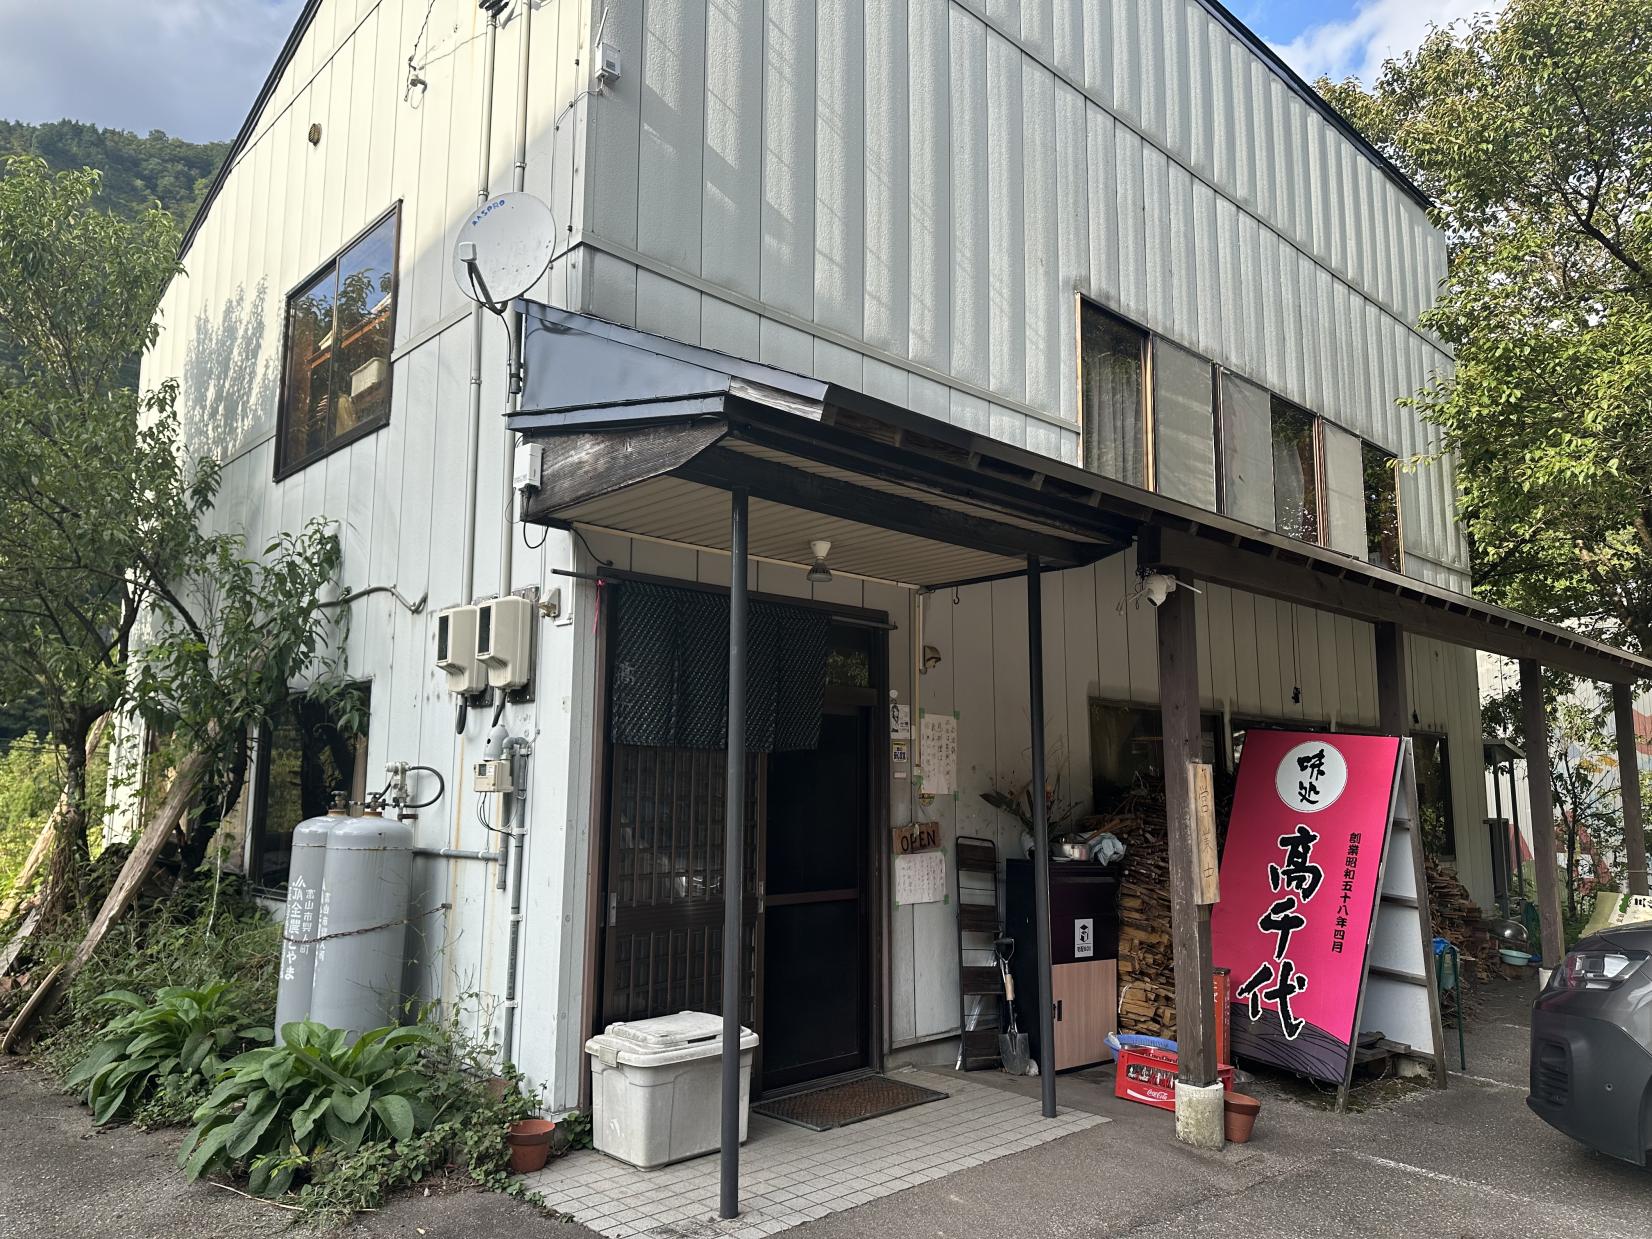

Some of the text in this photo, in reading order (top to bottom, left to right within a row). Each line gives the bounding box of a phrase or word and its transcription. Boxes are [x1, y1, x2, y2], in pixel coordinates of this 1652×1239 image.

[901, 829, 936, 852] OPEN
[1331, 831, 1361, 954] 創業昭和五十八年四月
[1236, 824, 1325, 1041] 高千代
